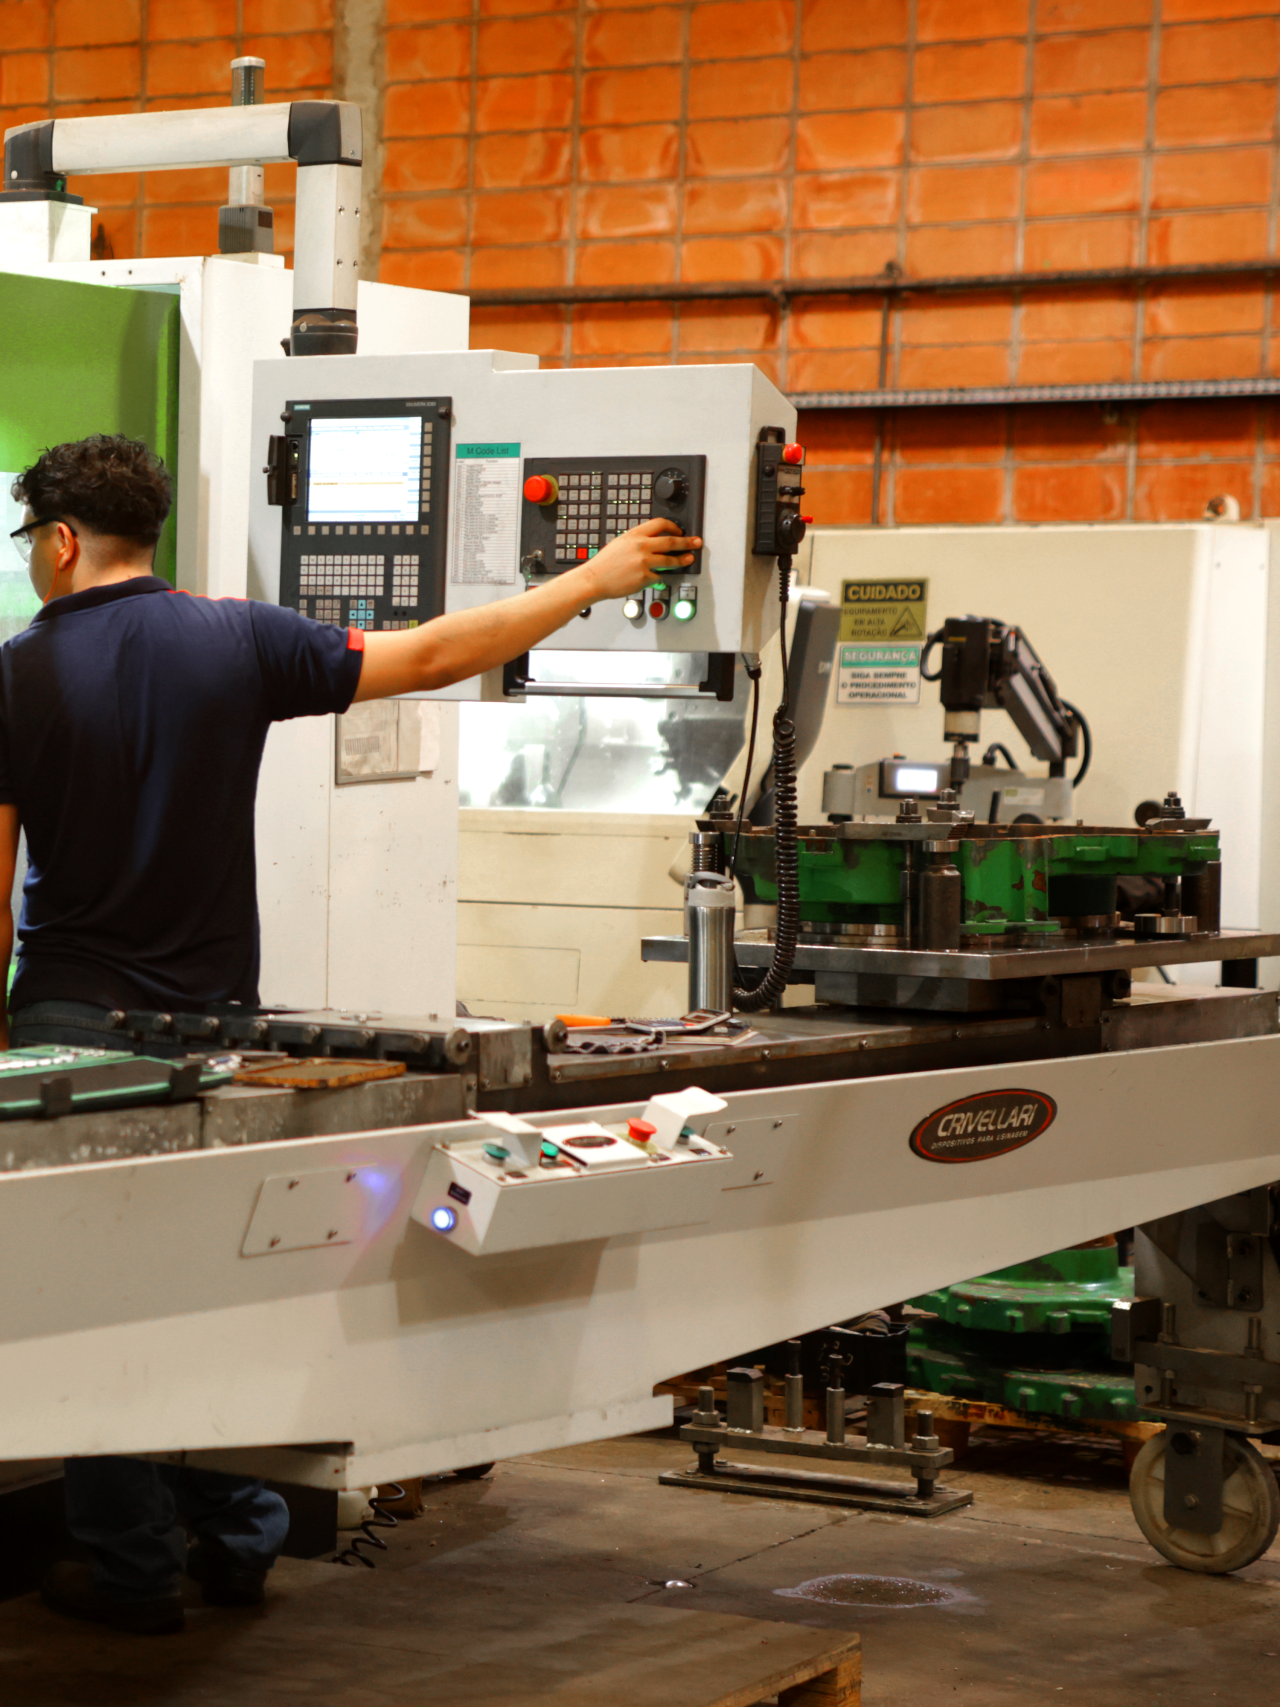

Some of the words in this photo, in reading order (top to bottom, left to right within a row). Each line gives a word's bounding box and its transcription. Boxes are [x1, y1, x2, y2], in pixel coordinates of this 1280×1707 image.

[466, 447, 474, 455] M
[475, 446, 495, 455] Code
[496, 446, 509, 455] List
[847, 584, 921, 600] CUIDADO
[866, 617, 886, 626] ALTA
[851, 627, 888, 638] ROTAÇÃO
[844, 650, 917, 665] SEGURANÇA
[850, 681, 917, 689] PROCEDIMENTO
[848, 691, 908, 699] OPERACIONAL
[937, 1103, 1038, 1137] CRIVELLARI
[930, 1137, 976, 1150] DISPOSITIVOS
[976, 1135, 994, 1143] PARA
[996, 1130, 1029, 1141] USINAGEM
